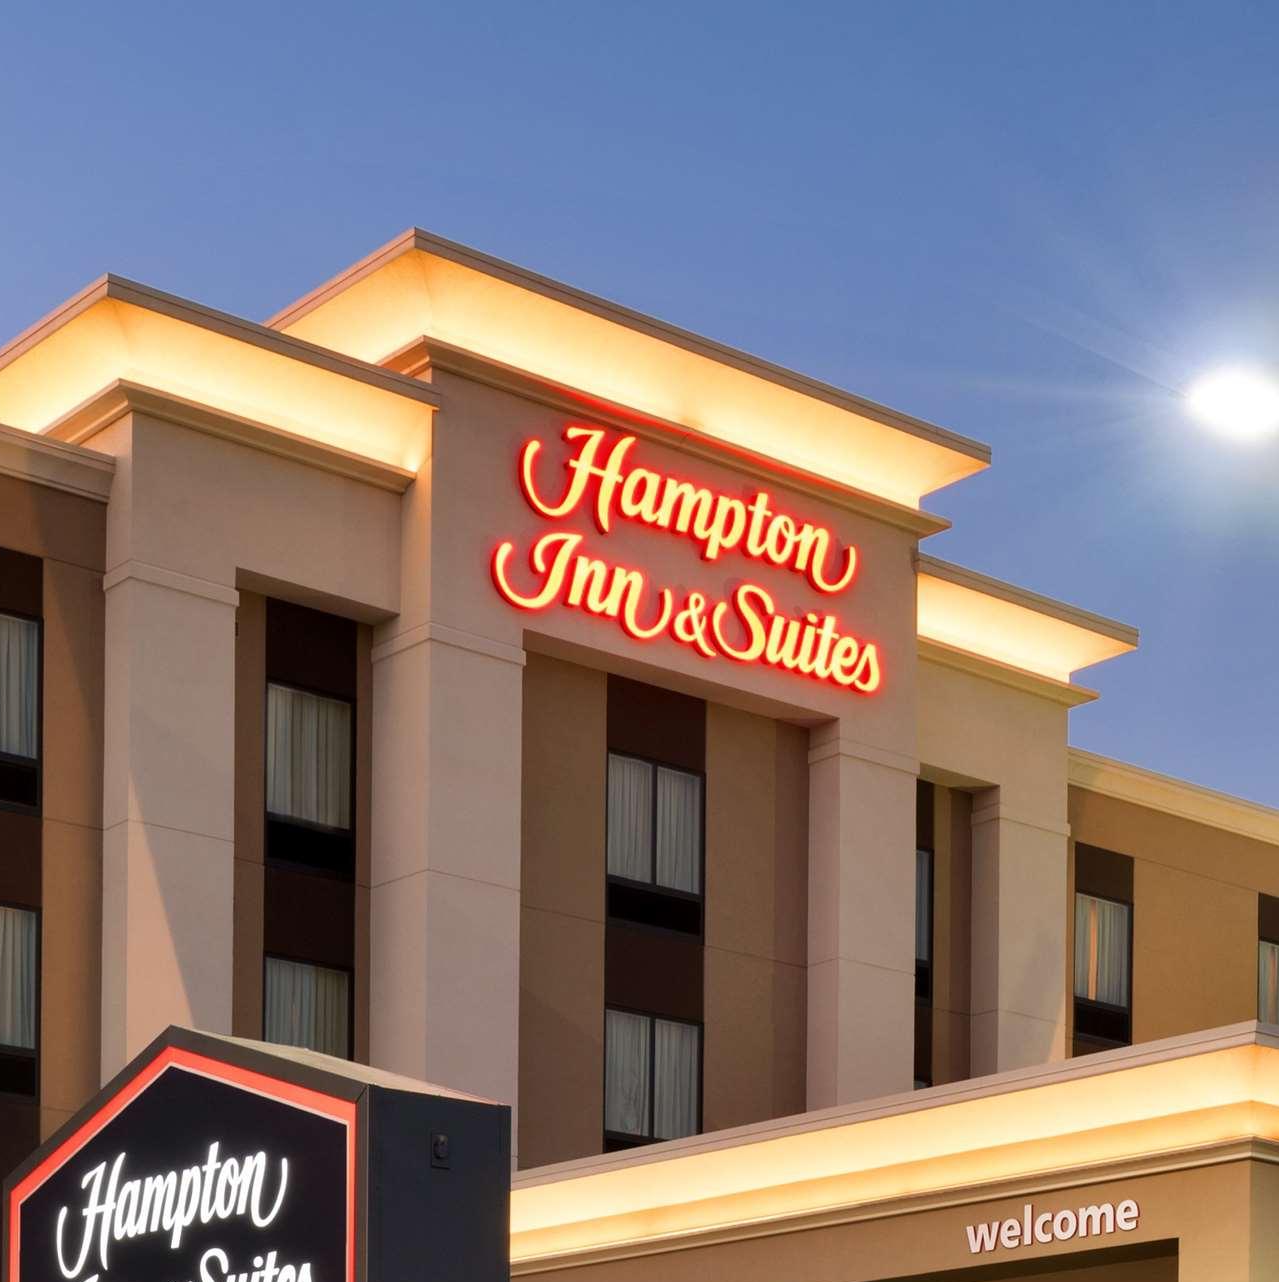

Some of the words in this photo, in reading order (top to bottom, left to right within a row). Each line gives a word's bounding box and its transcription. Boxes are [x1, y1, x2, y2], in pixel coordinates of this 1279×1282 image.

[522, 427, 856, 592] Hampton
[494, 532, 672, 638] Inn
[673, 593, 717, 658] &
[712, 584, 880, 692] Suites
[56, 1141, 288, 1279] Hampton
[966, 1199, 1140, 1254] welcome
